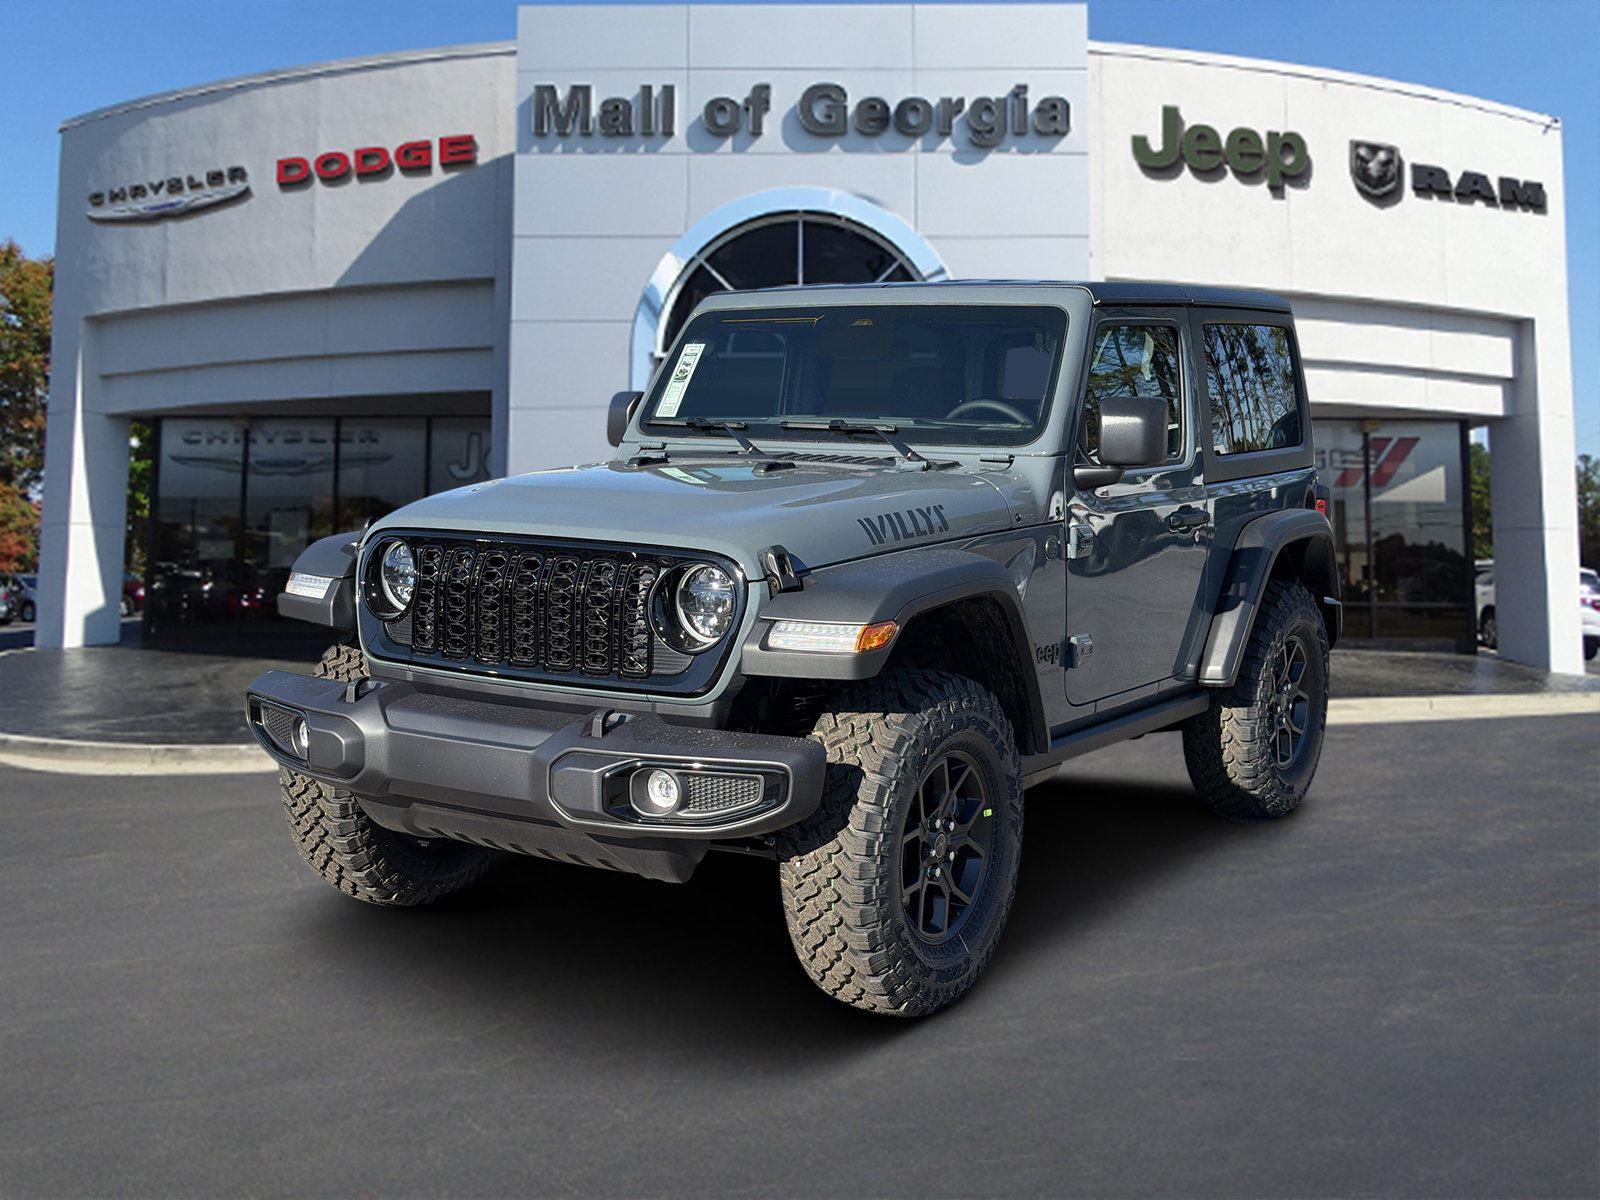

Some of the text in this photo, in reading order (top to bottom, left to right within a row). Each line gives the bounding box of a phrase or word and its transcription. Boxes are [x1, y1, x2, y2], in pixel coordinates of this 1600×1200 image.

[530, 82, 1072, 148] Mall of Georgia
[276, 133, 478, 188] DODGE
[1131, 105, 1310, 196] Jeep
[88, 165, 249, 208] CHRYSLER
[1410, 162, 1549, 215] RAM
[856, 504, 950, 546] WILLYS
